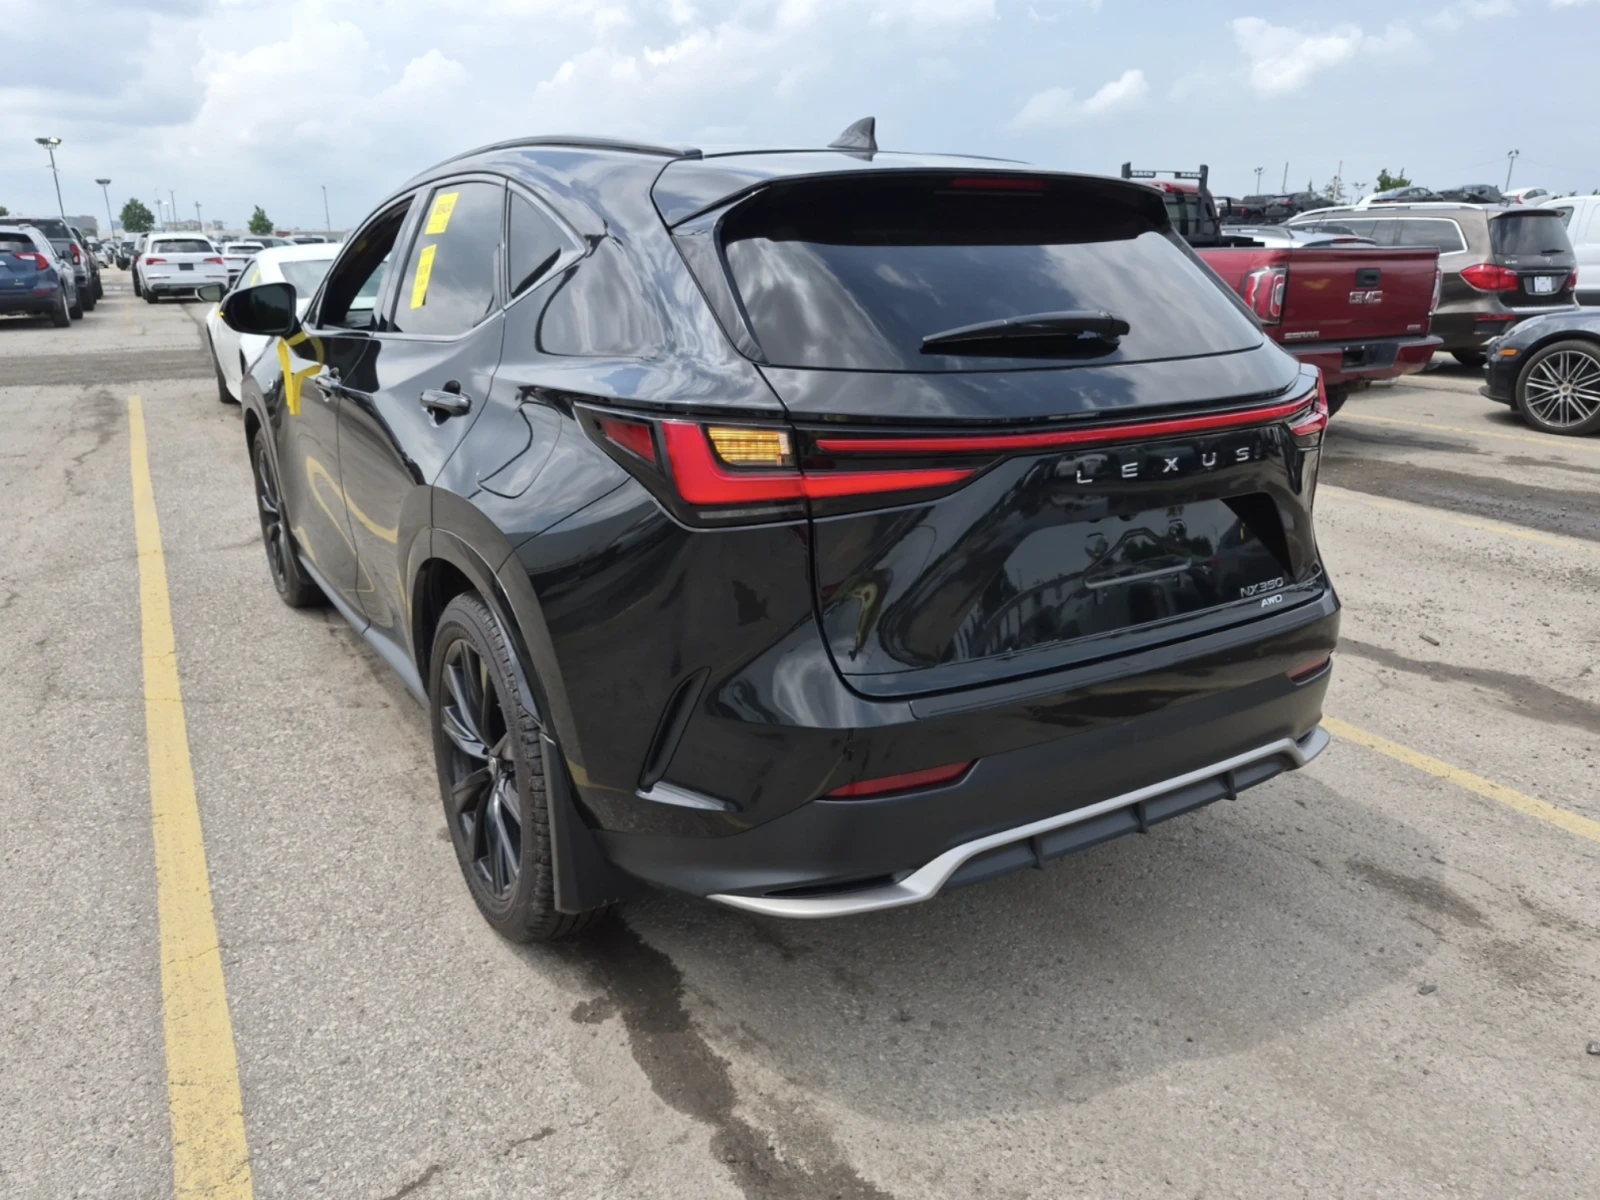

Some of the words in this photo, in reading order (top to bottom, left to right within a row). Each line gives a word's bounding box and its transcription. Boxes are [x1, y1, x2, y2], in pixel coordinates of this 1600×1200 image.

[1349, 290, 1383, 304] GMC
[1076, 447, 1250, 484] LEXUS
[1261, 594, 1283, 608] AWD
